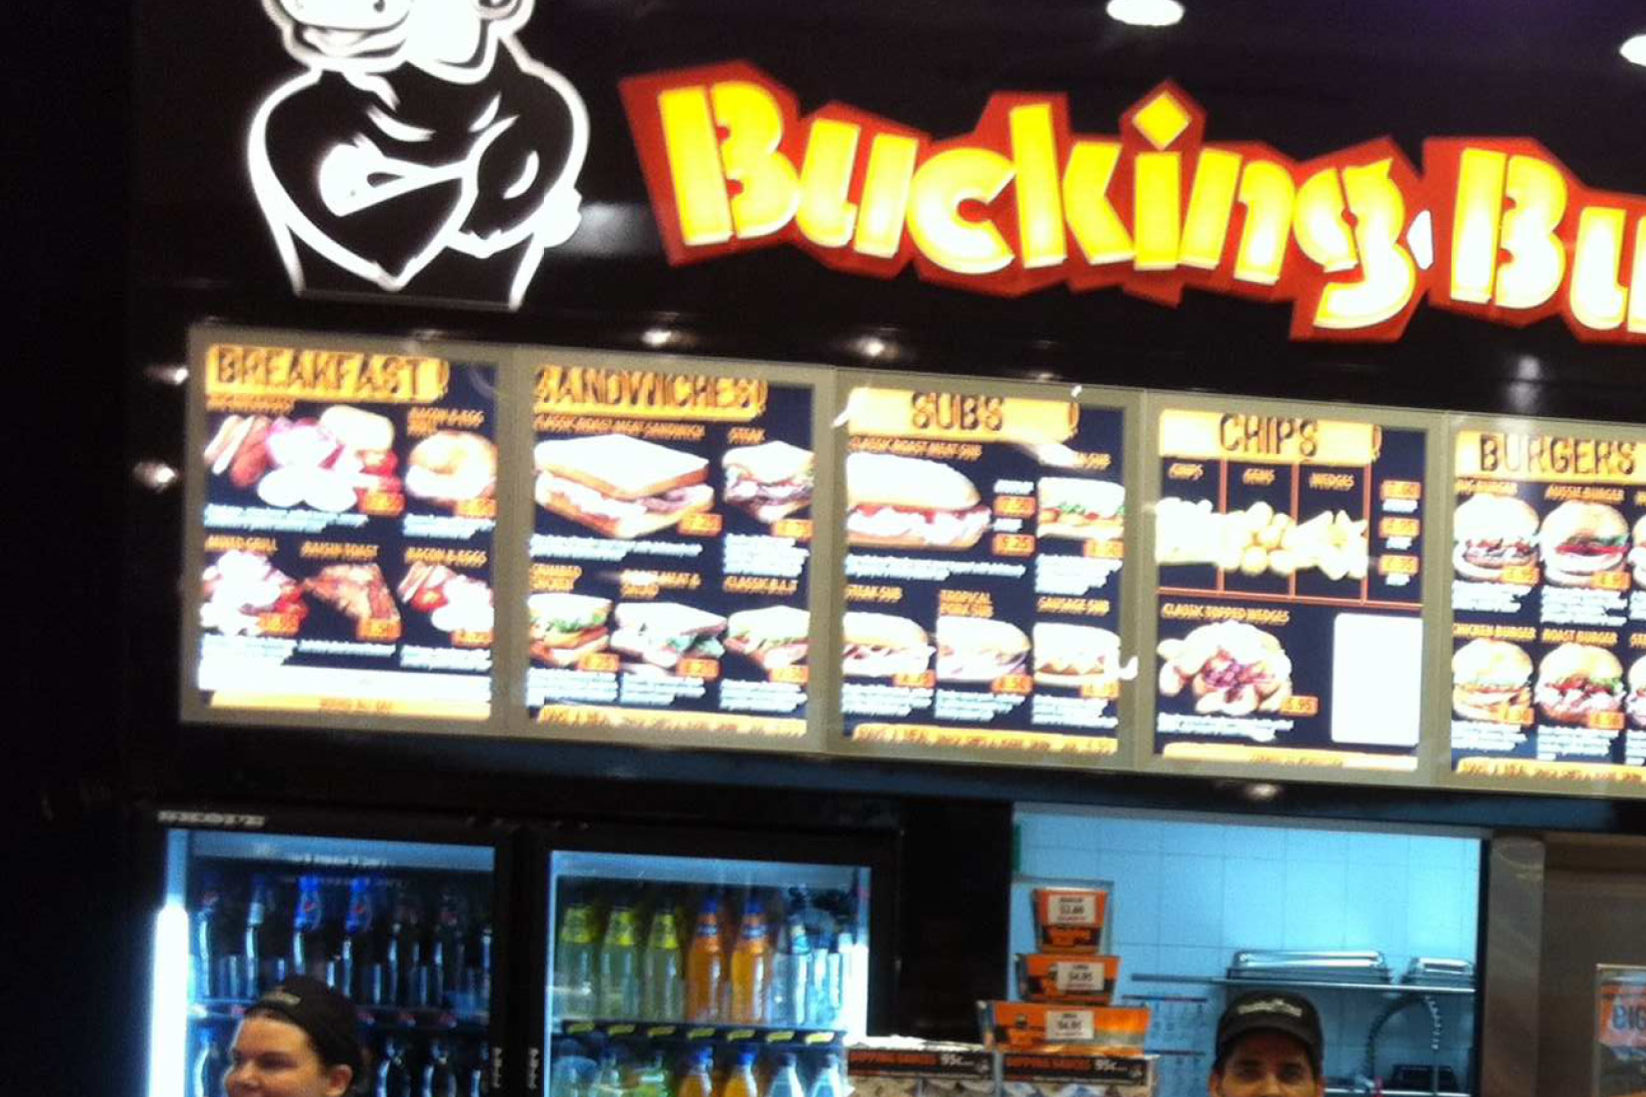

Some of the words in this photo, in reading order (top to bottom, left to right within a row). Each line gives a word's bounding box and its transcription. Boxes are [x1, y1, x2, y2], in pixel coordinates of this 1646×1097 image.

[650, 76, 1416, 333] Bucking
[215, 348, 427, 399] BREAKFAST
[912, 391, 1003, 431] SUBS
[1220, 412, 1318, 457] CHIPS
[1480, 433, 1636, 475] BURGERS
